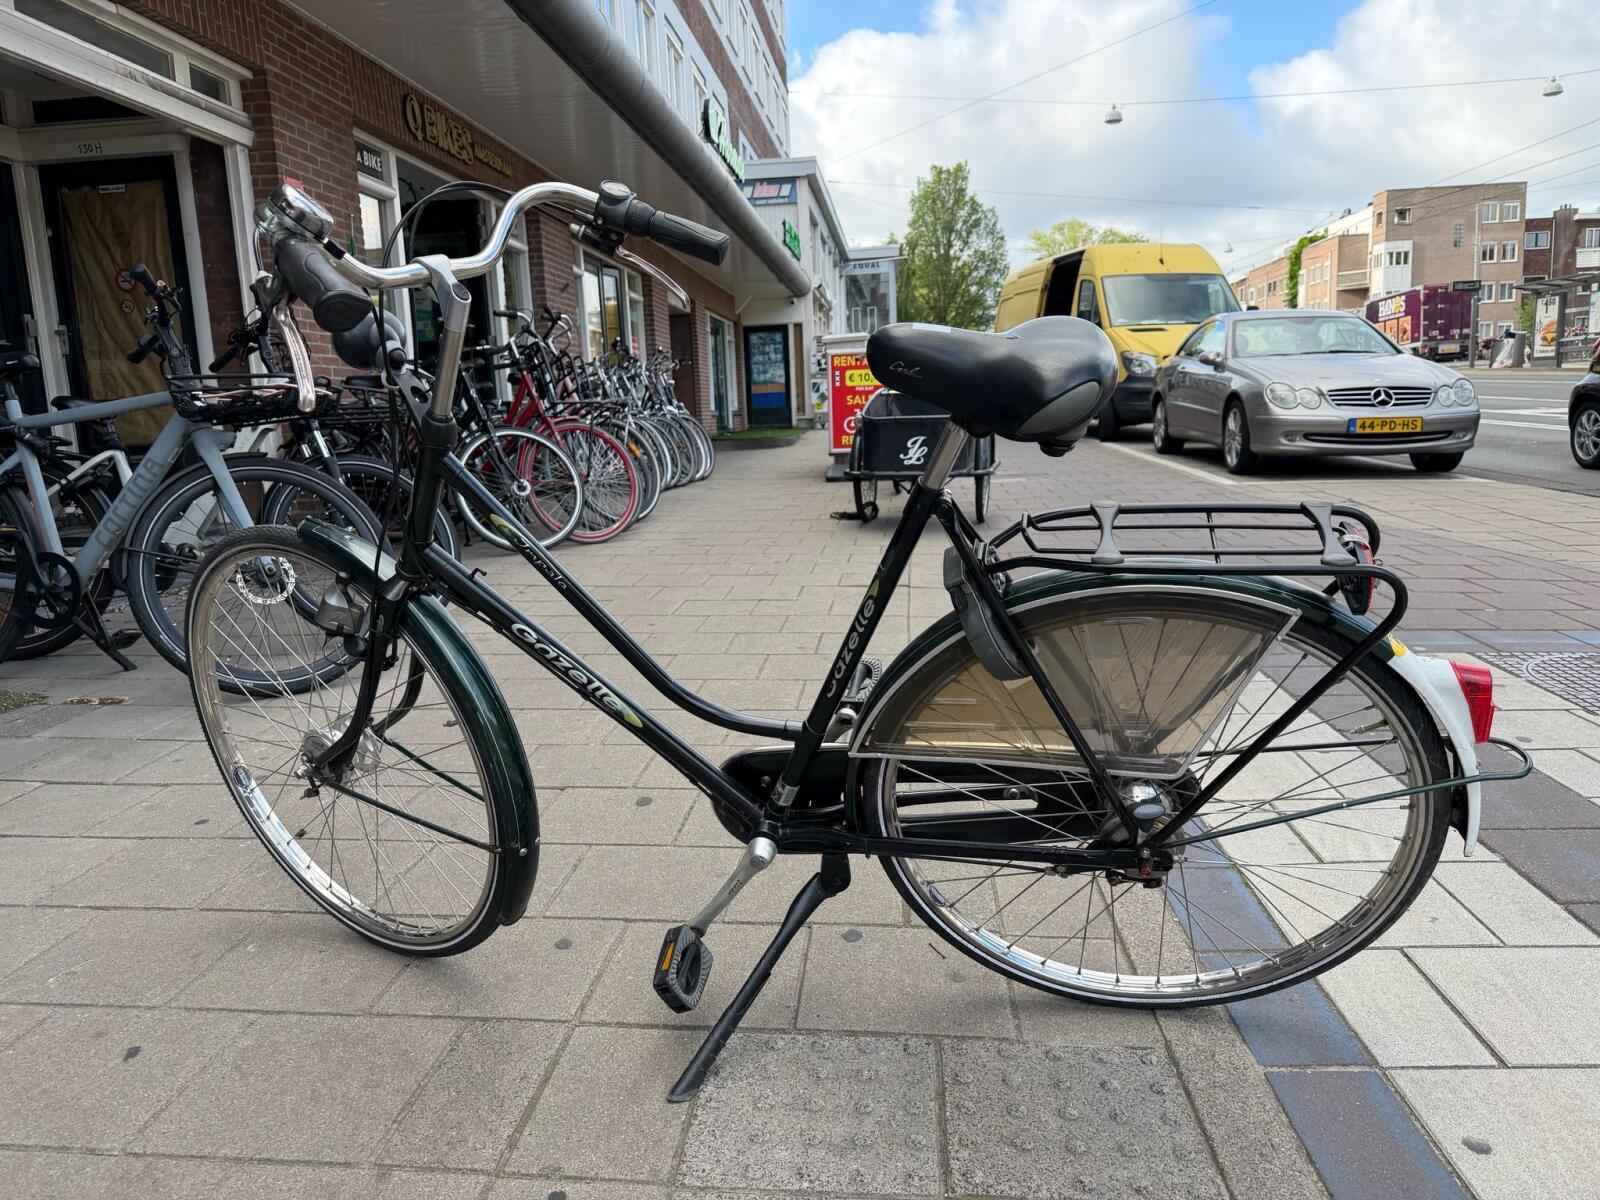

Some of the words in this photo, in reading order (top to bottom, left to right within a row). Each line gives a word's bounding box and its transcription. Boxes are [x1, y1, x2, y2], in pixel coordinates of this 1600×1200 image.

[363, 150, 382, 172] BIKE
[424, 104, 474, 165] BIKES
[1358, 420, 1418, 431] 44-PD-HS
[514, 537, 567, 590] Impala
[511, 623, 621, 711] Gazelle
